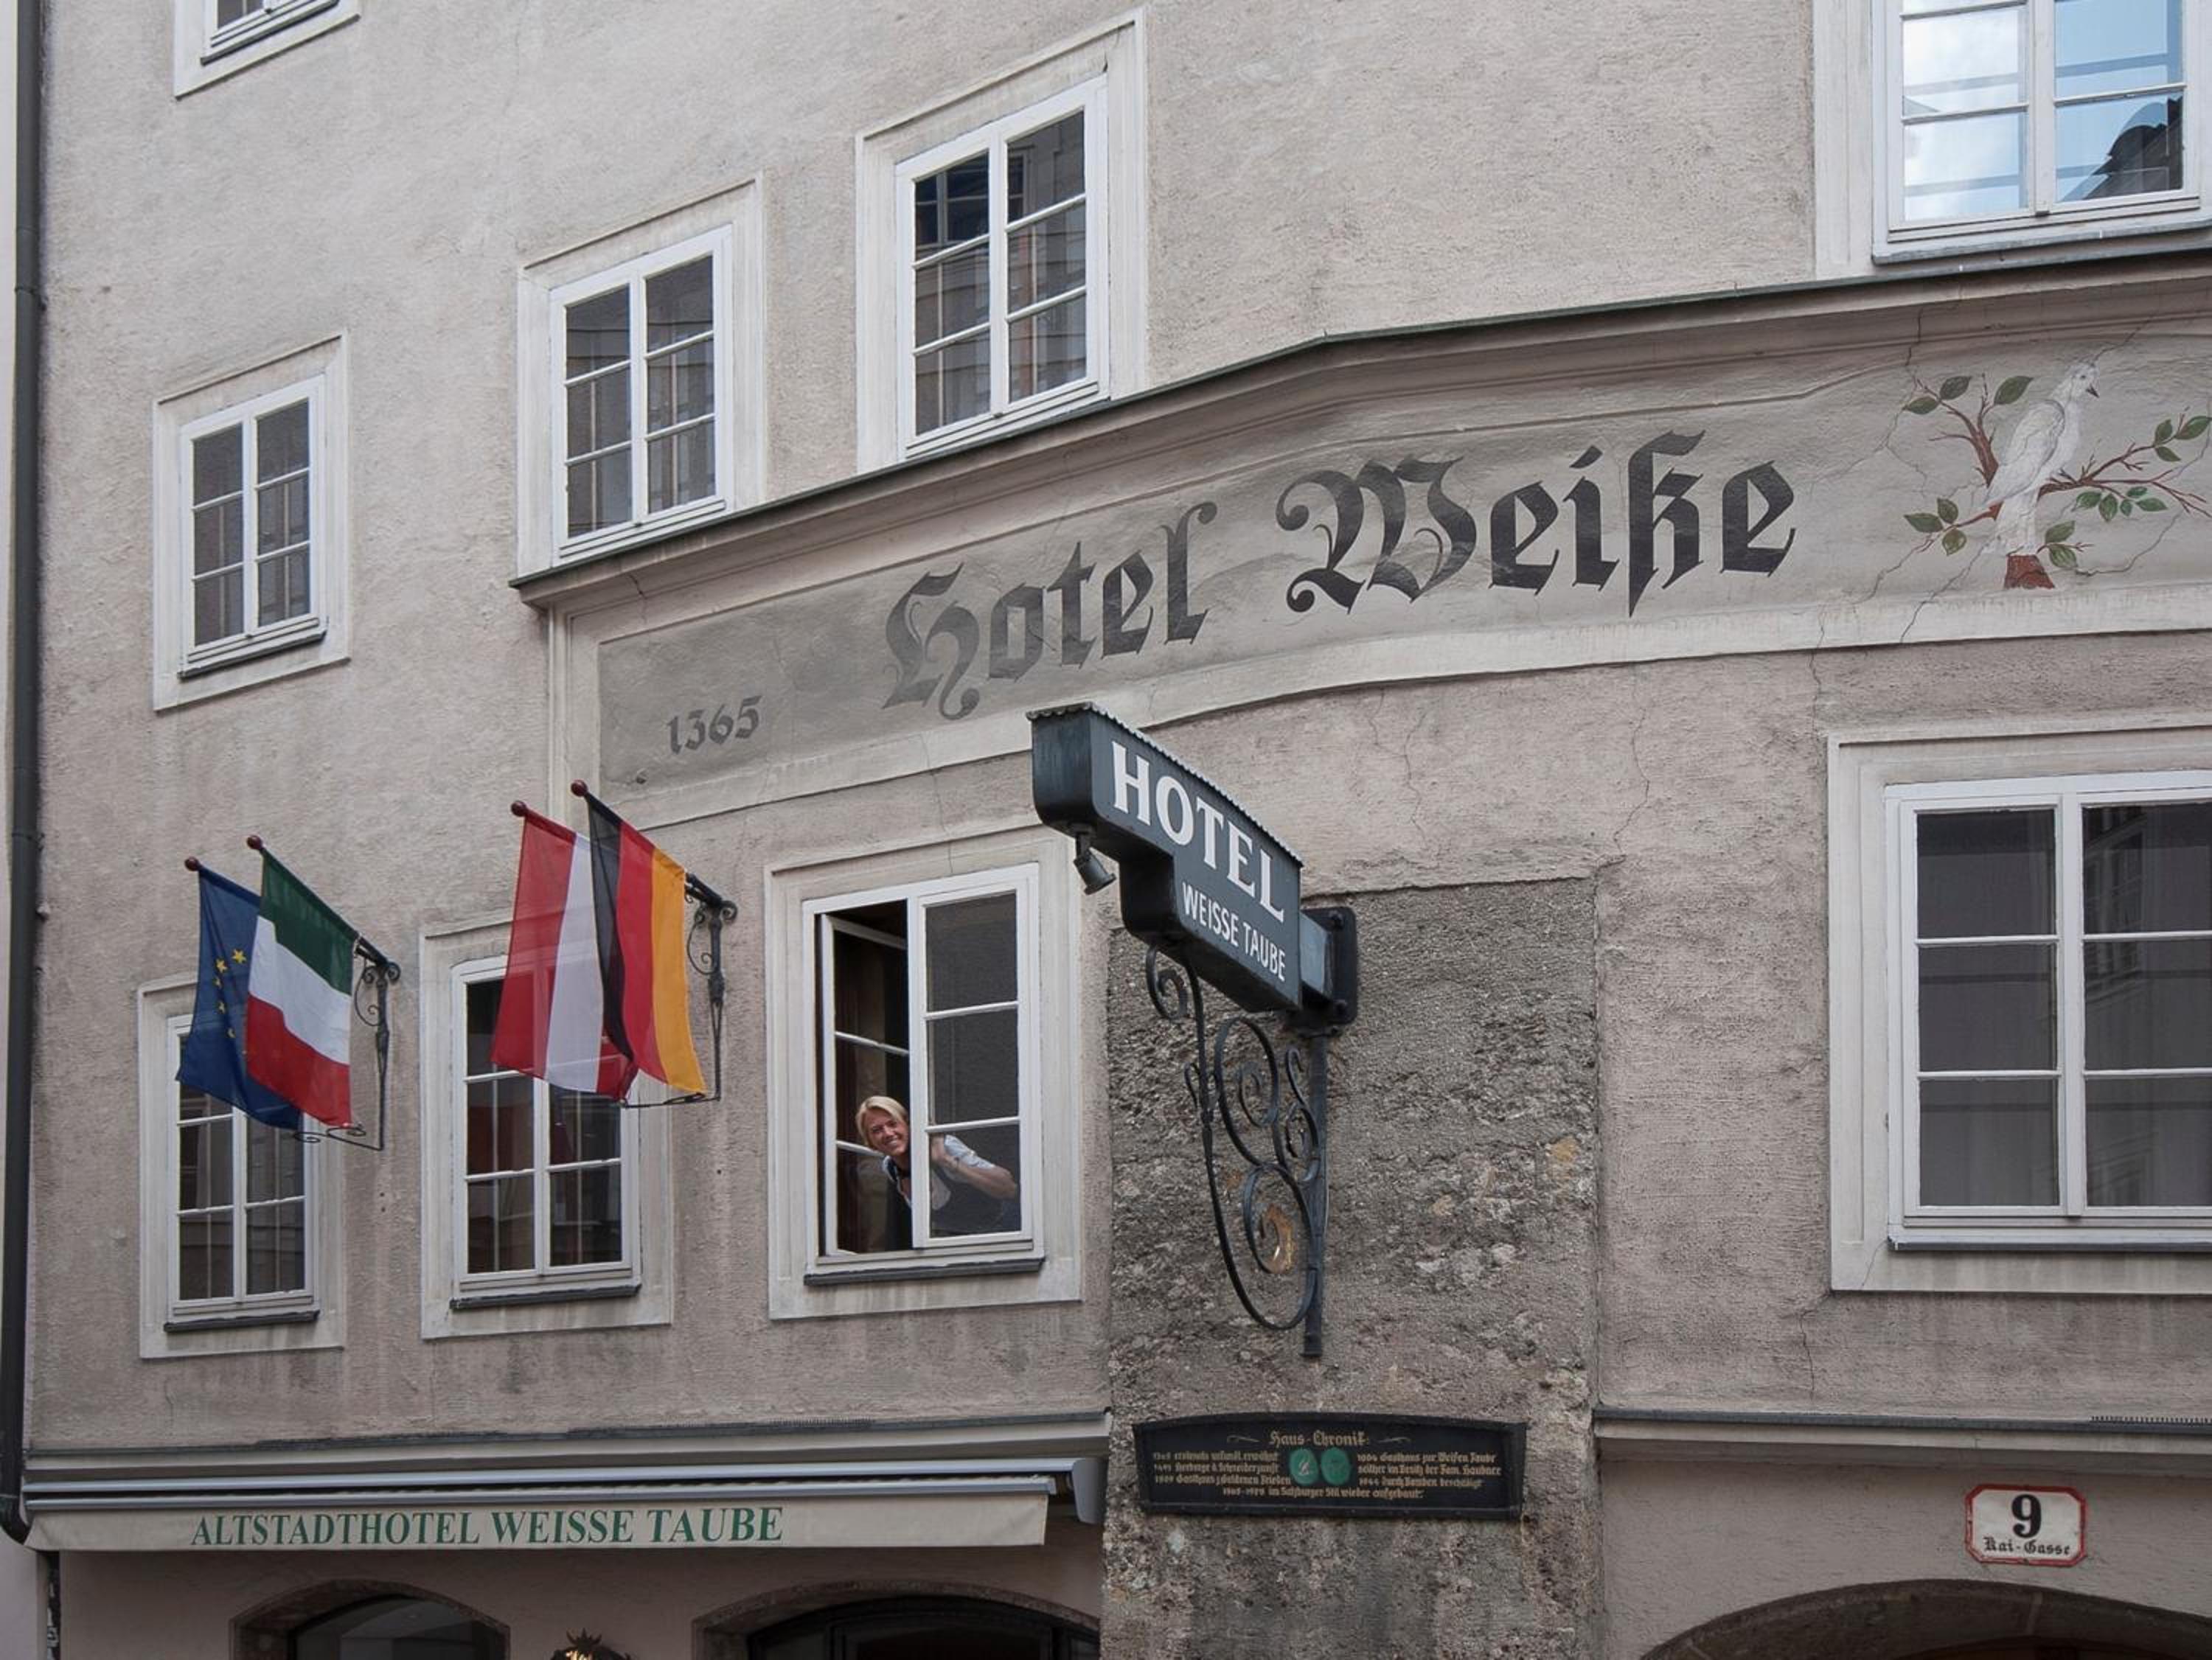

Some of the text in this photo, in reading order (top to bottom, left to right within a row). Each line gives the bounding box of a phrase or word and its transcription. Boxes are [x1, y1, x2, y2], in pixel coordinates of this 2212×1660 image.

[881, 501, 1217, 720] Hotel
[667, 695, 762, 755] 1365
[1112, 740, 1284, 923] HOTEL
[1182, 882, 1286, 982] WEISSE TAUBE
[190, 1507, 784, 1546] ALTSTADTHOTEL WEISSE TAUBE
[1983, 1536, 2071, 1555] Kai-Gasse
[2011, 1494, 2042, 1538] 9
